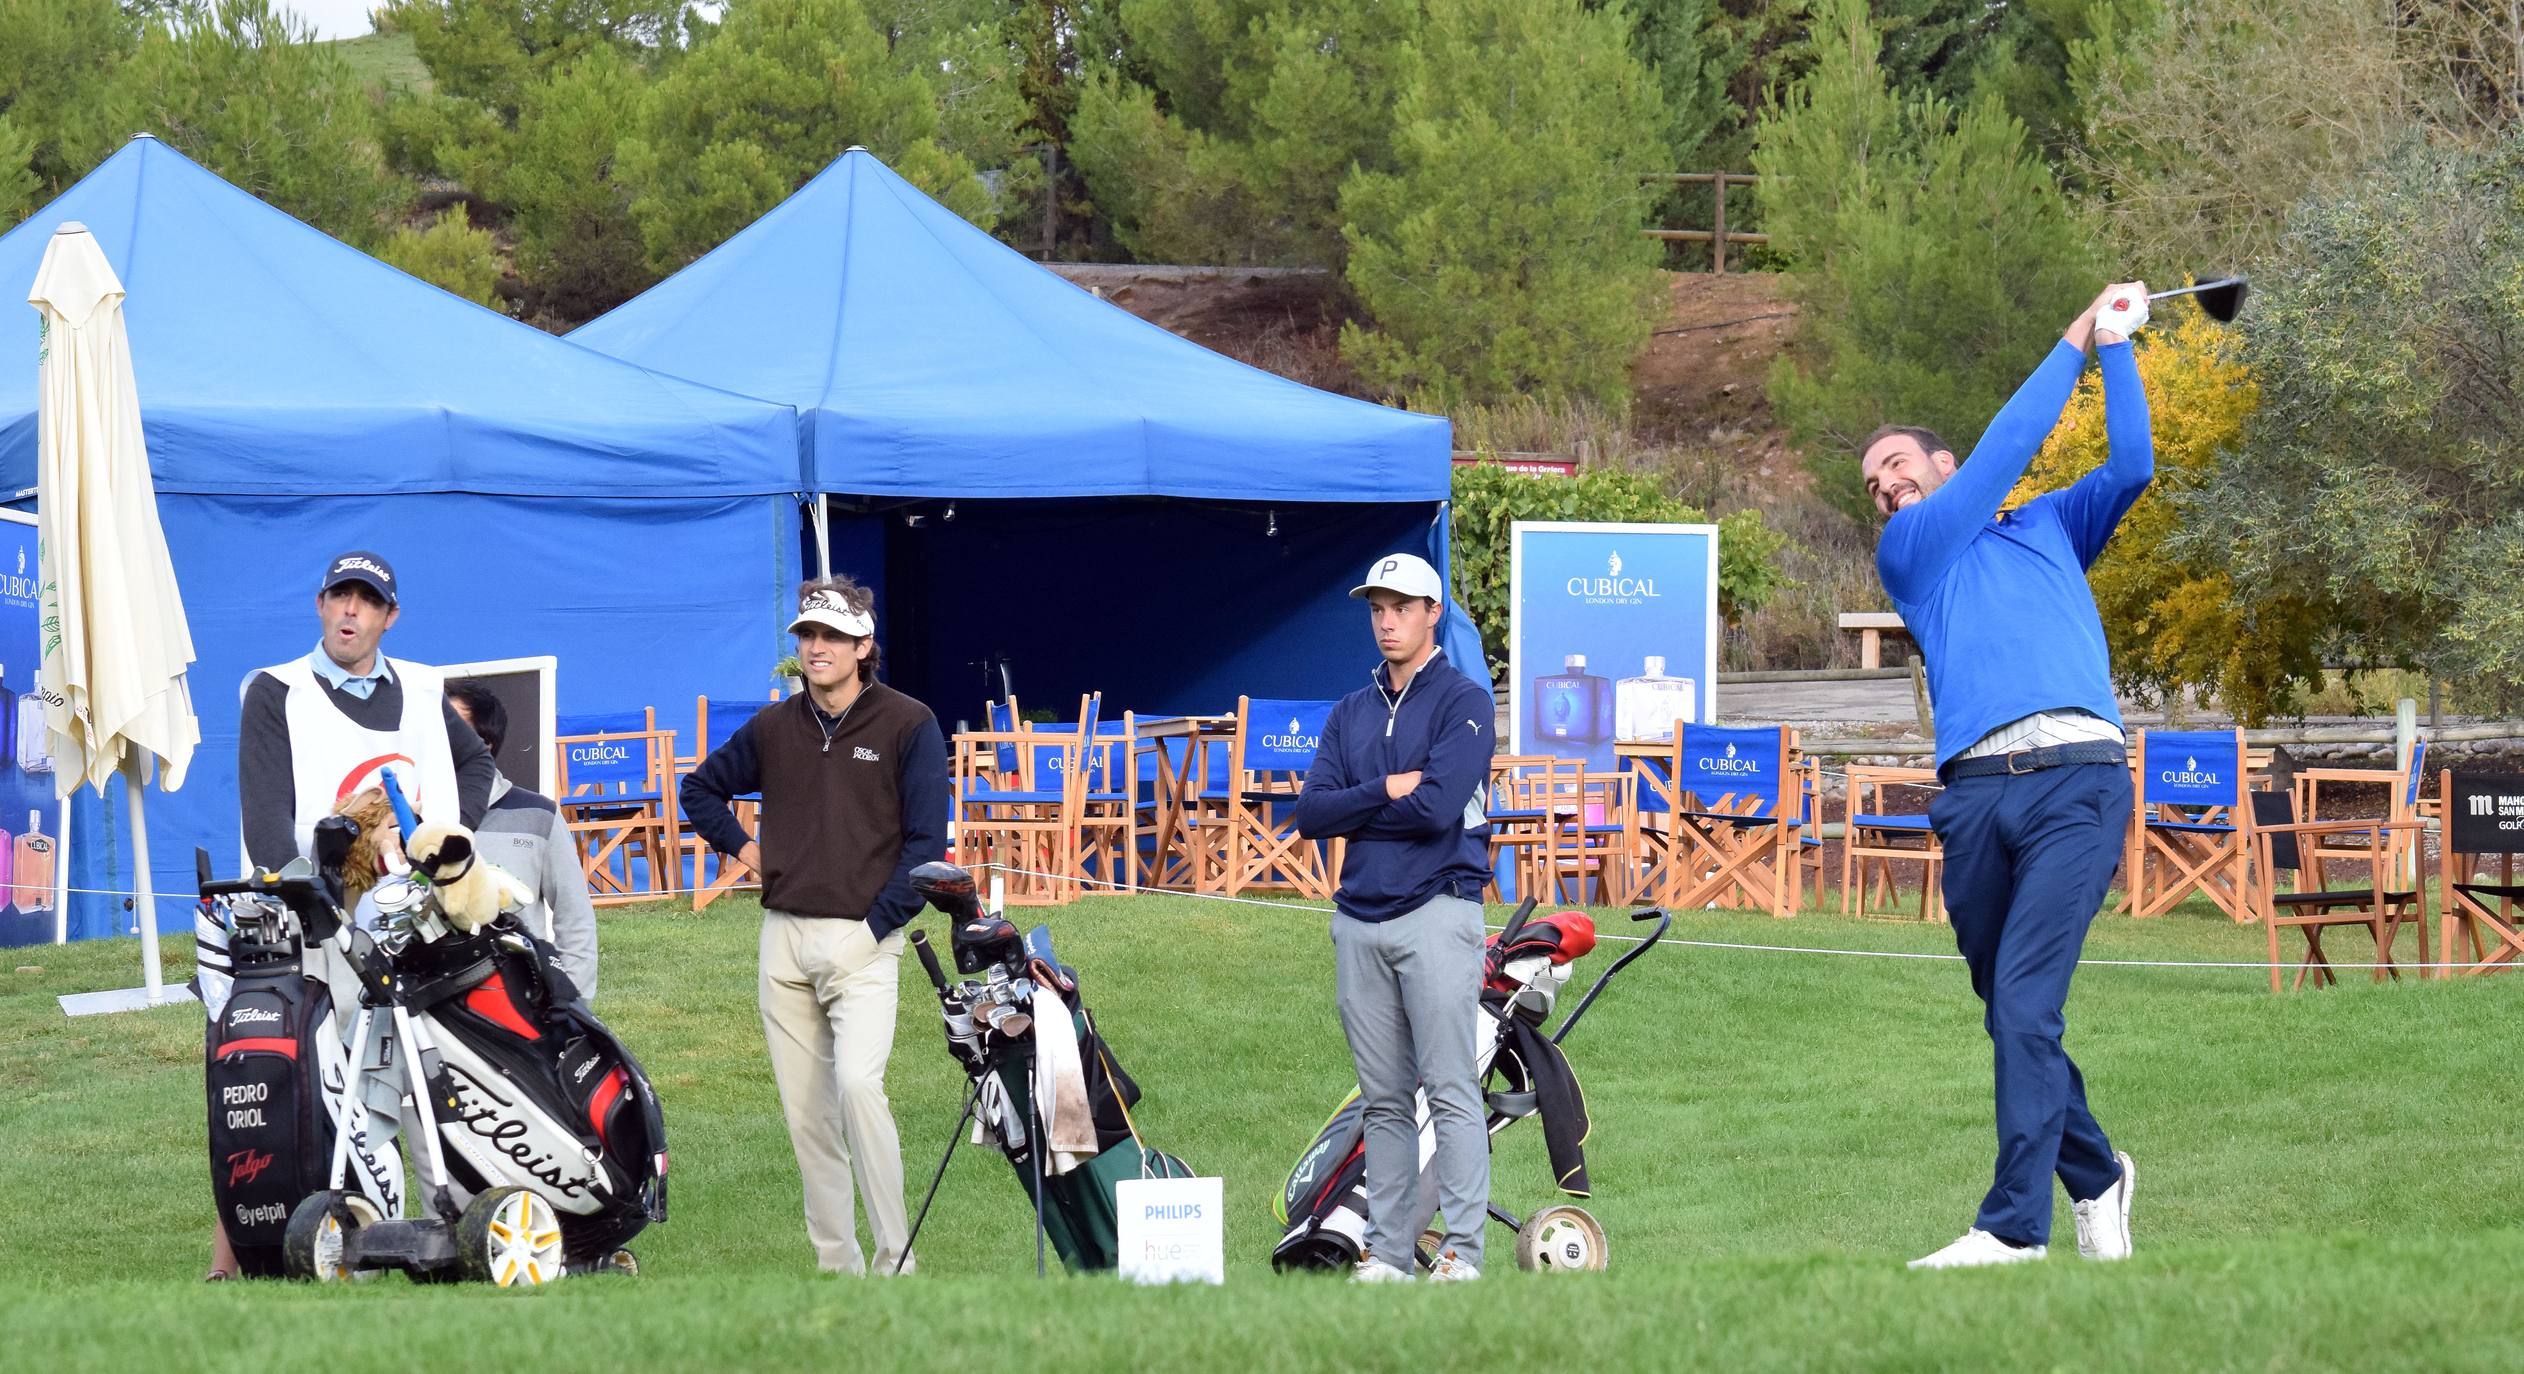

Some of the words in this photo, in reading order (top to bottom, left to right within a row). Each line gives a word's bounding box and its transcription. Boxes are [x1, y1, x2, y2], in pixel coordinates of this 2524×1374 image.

[334, 556, 391, 582] Titleist
[1380, 560, 1398, 580] P
[1567, 577, 1661, 597] CUBICAL
[1585, 597, 1614, 605] LONDON
[1546, 681, 1581, 689] CUBICAL
[572, 746, 630, 762] CUBICAL
[1699, 757, 1761, 772] CUBICAL
[2162, 770, 2221, 785] CUBICAL
[2498, 806, 2514, 816] SAN
[513, 837, 534, 846] BOSS
[229, 1007, 281, 1027] Titleist
[223, 1082, 268, 1105] PEDRO
[227, 1108, 267, 1130] ORIOL
[227, 1148, 274, 1188] Talgo
[236, 1202, 287, 1227] @yetpit
[1145, 1204, 1202, 1220] PHILIPS
[1145, 1240, 1181, 1261] hue
